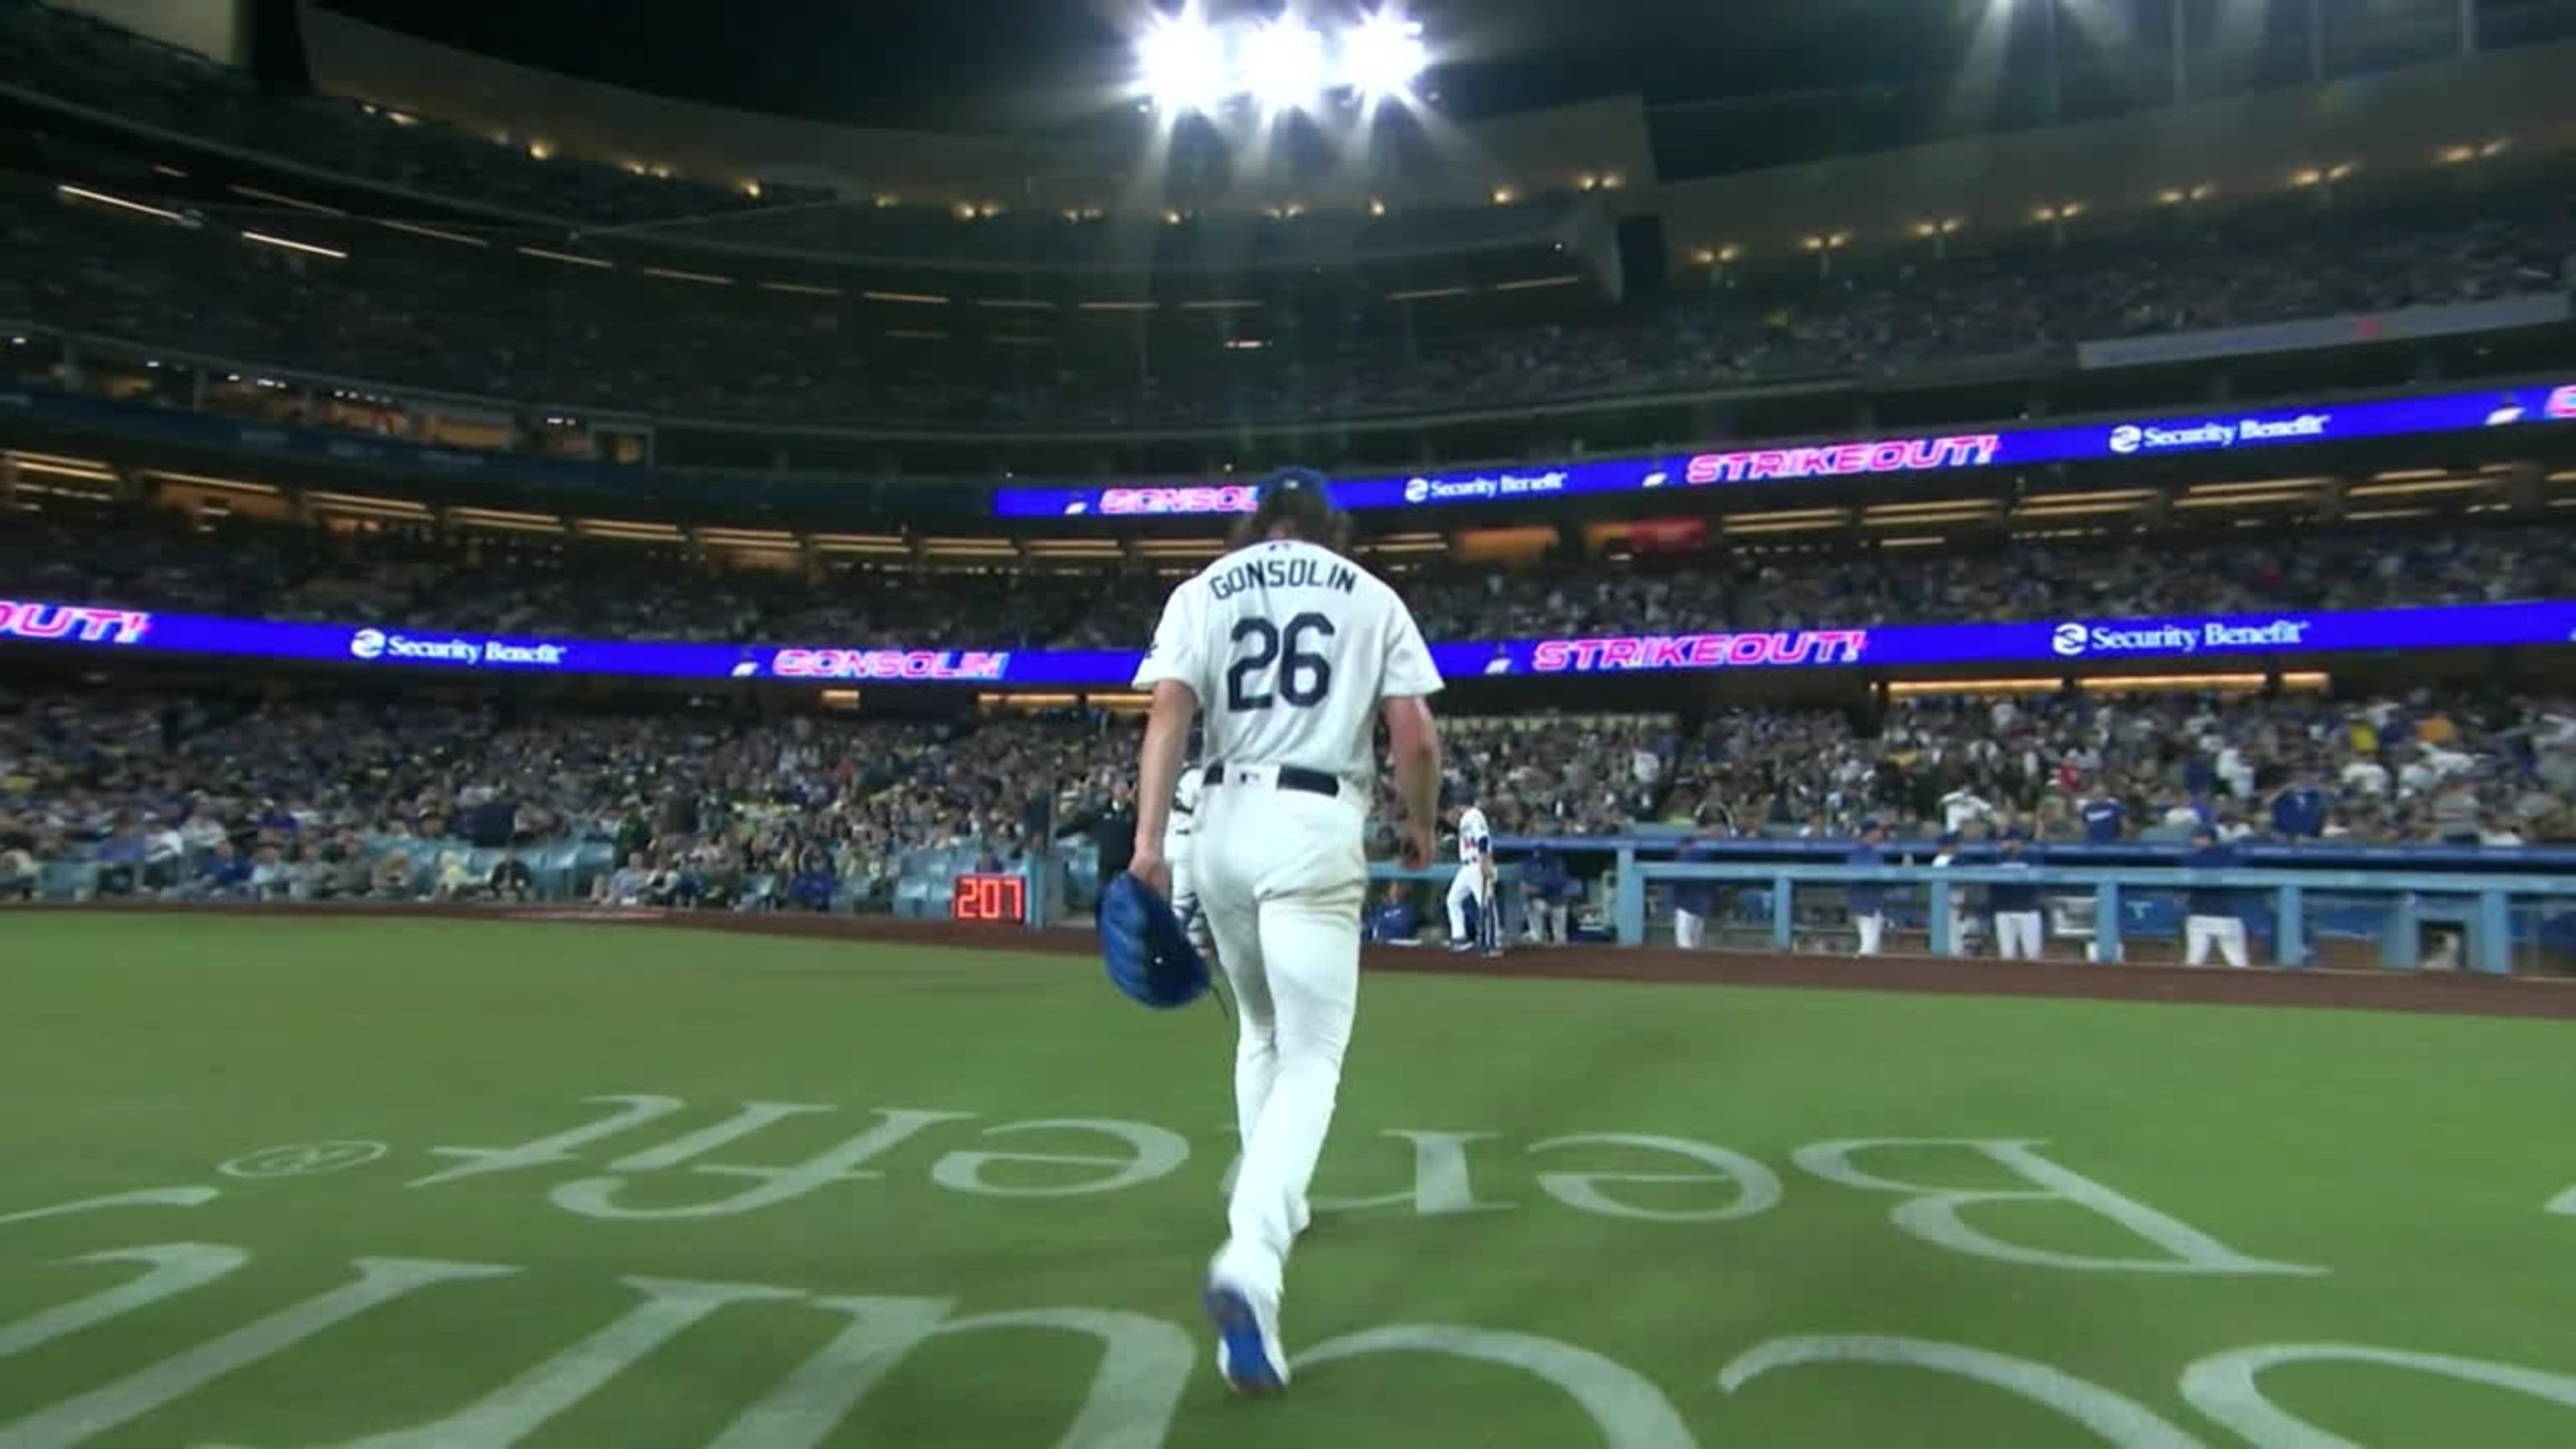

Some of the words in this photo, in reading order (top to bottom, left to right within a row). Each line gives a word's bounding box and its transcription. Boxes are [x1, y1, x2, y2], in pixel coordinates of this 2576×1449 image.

[2143, 421, 2236, 448] Security
[1686, 434, 2002, 485] STRIKEOUT!
[1430, 476, 1498, 499] Security
[1210, 558, 1358, 600] GONSOLIN
[387, 635, 480, 665] Security
[1533, 630, 1867, 672] STRIKEOUT!
[2091, 625, 2200, 653] Security
[772, 648, 1010, 679] GONSOLIN
[1227, 611, 1336, 713] 26
[957, 877, 1022, 920] 207
